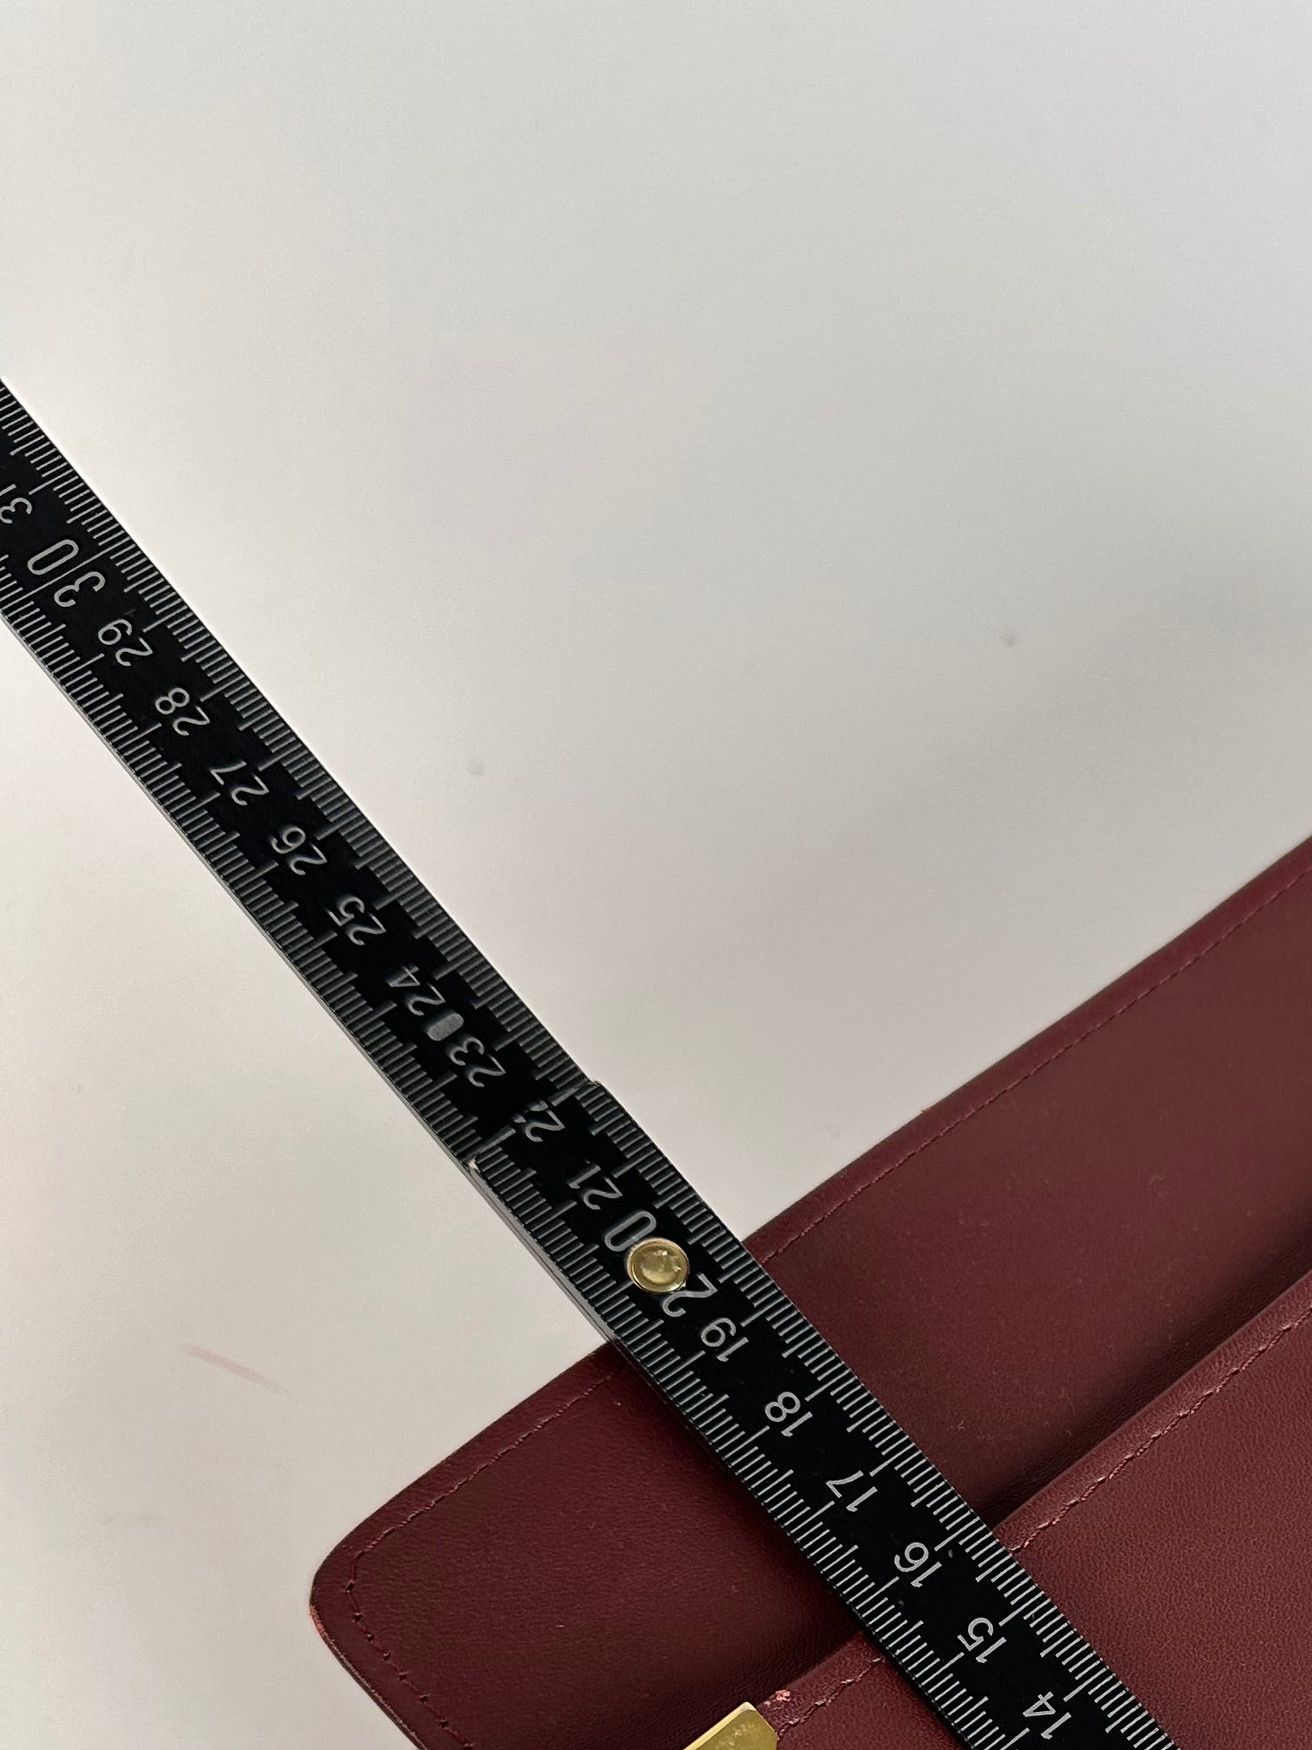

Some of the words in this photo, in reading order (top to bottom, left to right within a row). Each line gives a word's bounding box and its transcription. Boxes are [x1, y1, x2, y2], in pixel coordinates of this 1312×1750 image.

[27, 539, 106, 608] 30
[97, 618, 153, 667] 29
[154, 687, 211, 736] 28
[210, 760, 270, 806] 27
[271, 825, 328, 876] 26
[327, 895, 387, 947] 25
[387, 965, 446, 1016] 24
[450, 1036, 506, 1089] 23
[568, 1163, 623, 1210] 21
[604, 1210, 717, 1318] 20
[700, 1317, 750, 1363] 19
[764, 1391, 813, 1438] 18
[825, 1470, 878, 1513] 17
[894, 1541, 942, 1588] 16
[957, 1617, 1007, 1664] 15
[1022, 1691, 1072, 1740] 14
